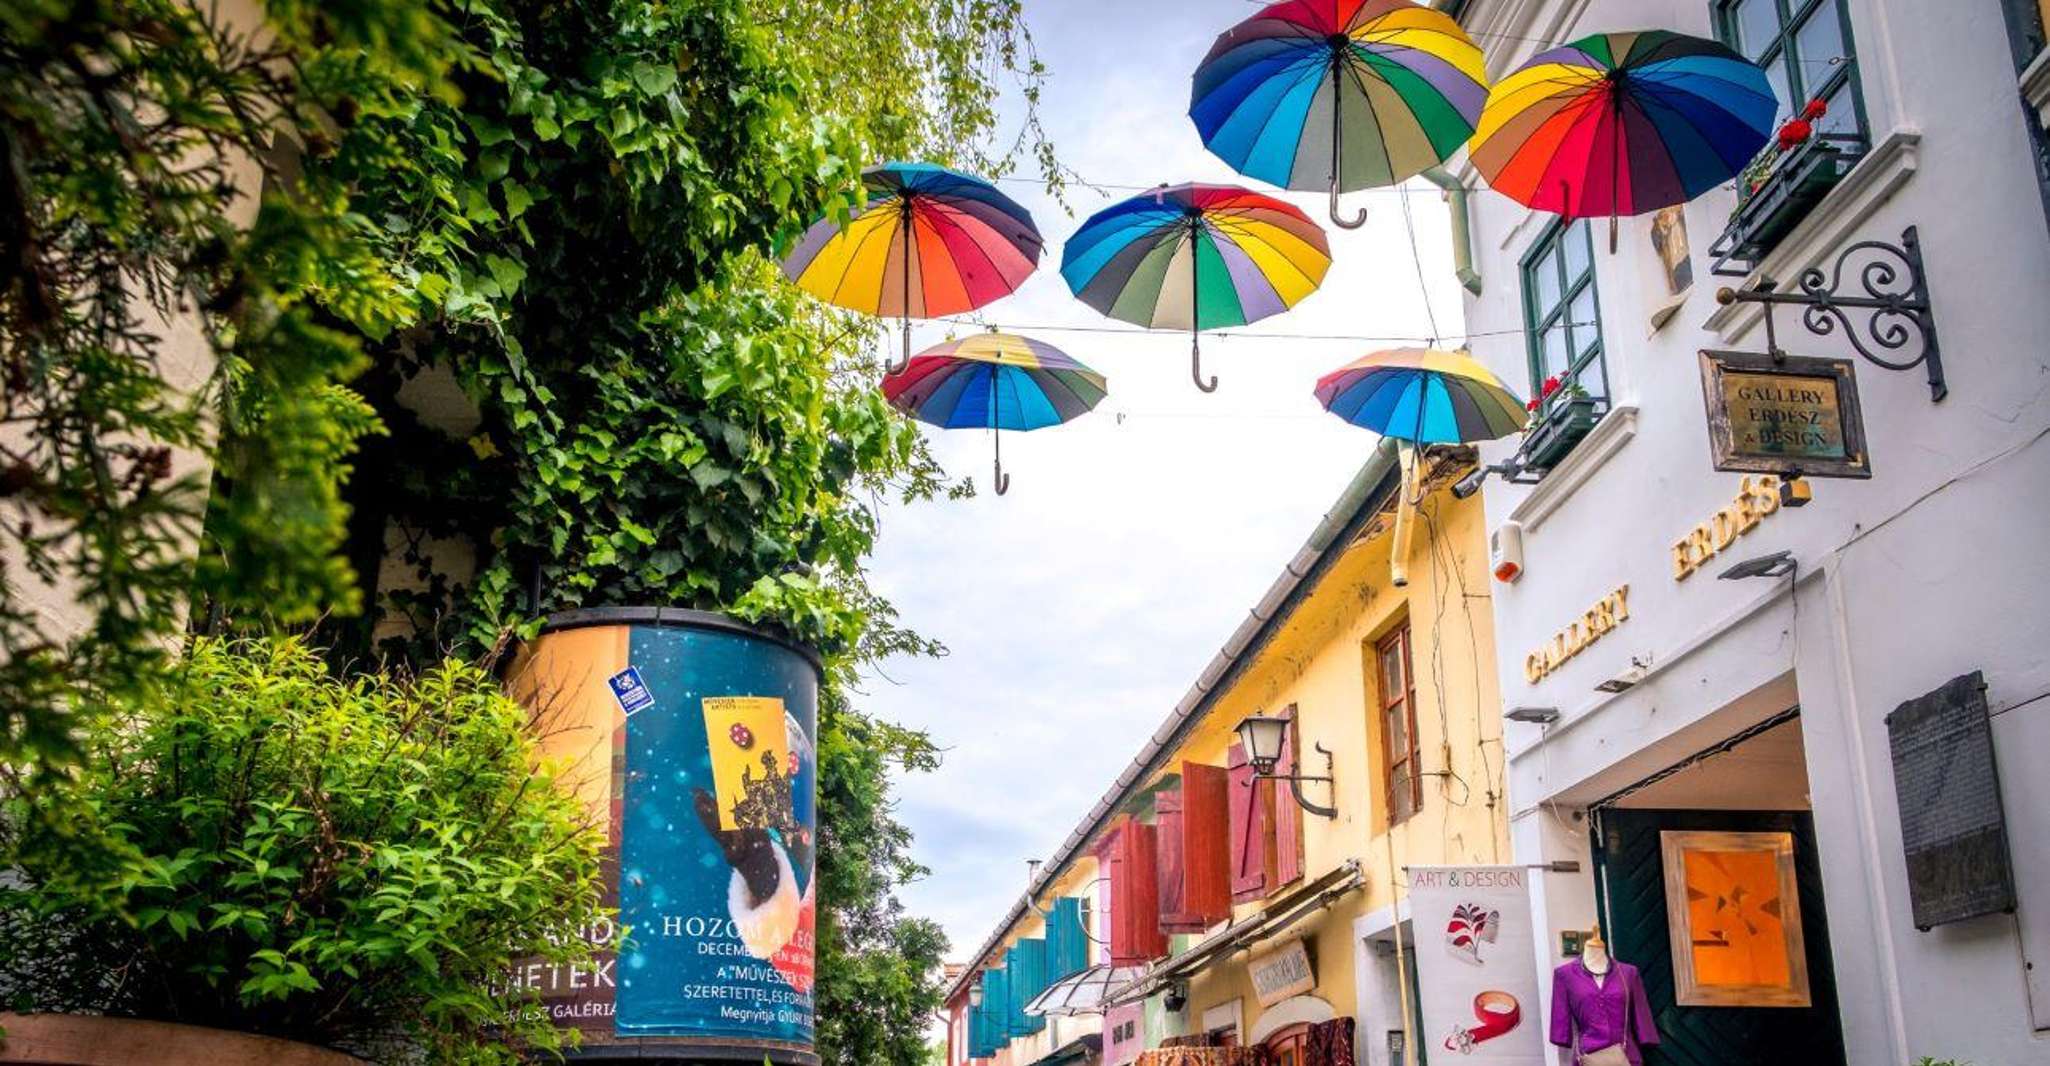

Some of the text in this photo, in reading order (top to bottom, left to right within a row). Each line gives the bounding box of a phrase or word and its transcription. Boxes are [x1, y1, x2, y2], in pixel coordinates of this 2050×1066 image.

[1738, 386, 1824, 405] GALLERY
[1745, 428, 1826, 446] & DESIGN
[1524, 583, 1630, 686] GALLERY
[1415, 871, 1521, 888] ART & DESIGN
[720, 1004, 776, 1024] Megnyitja
